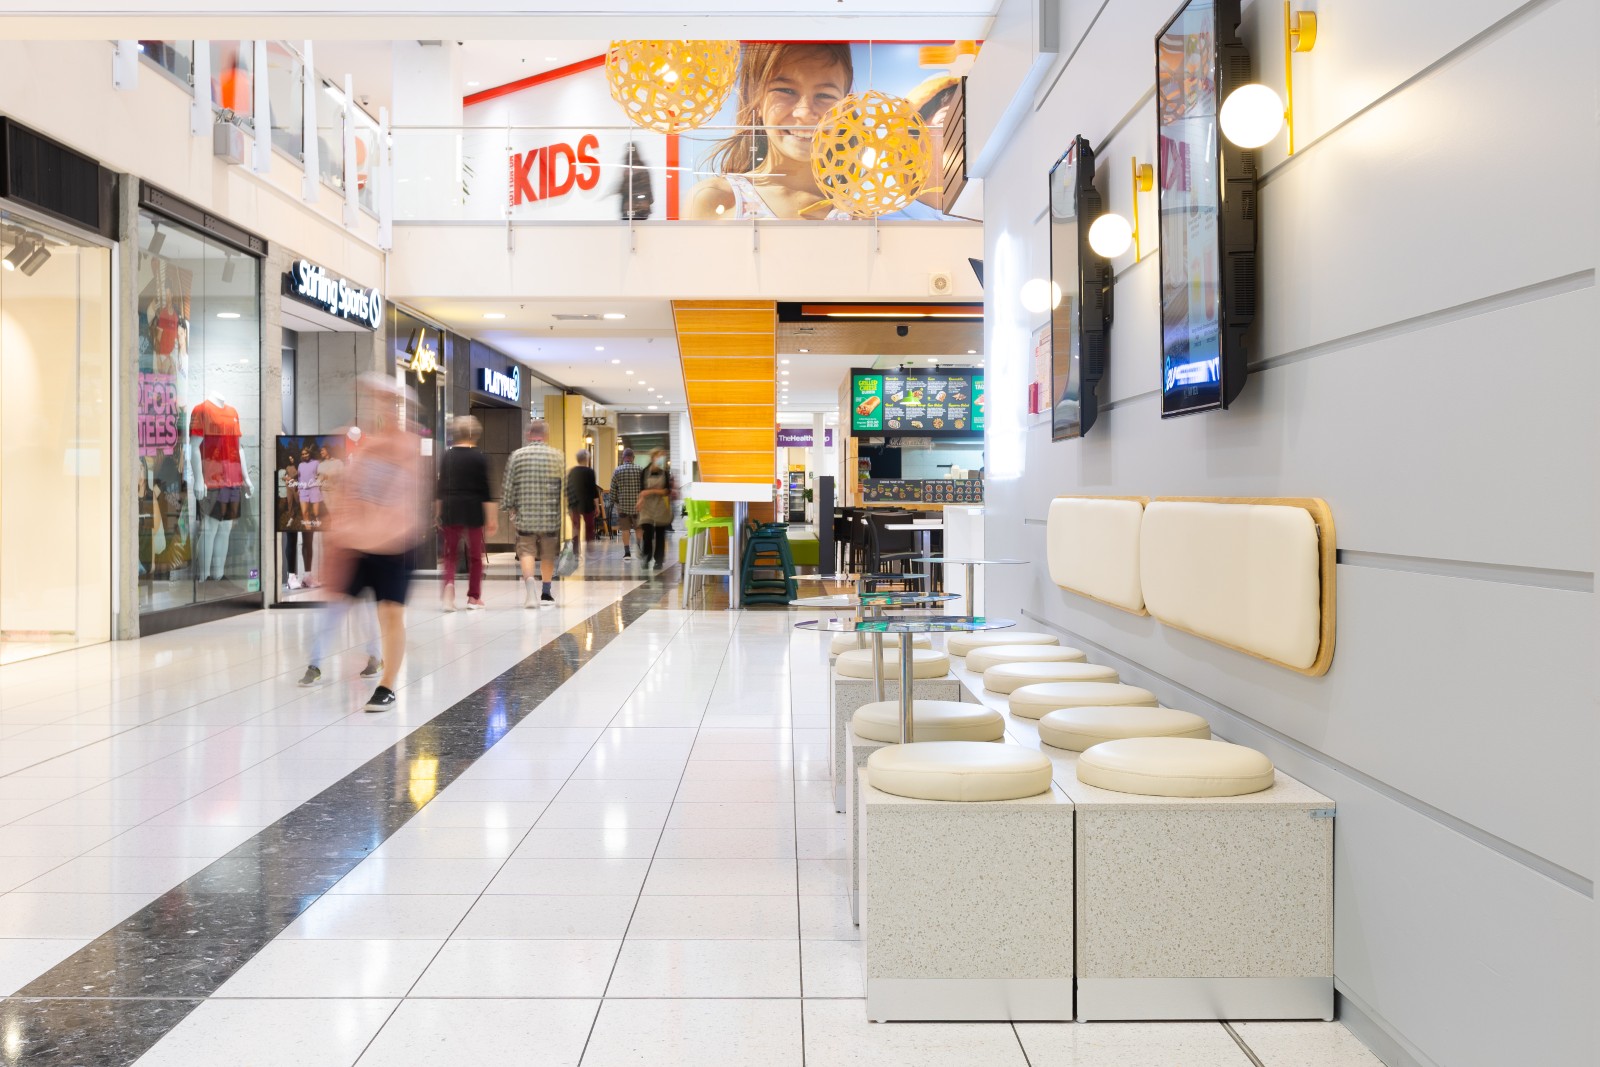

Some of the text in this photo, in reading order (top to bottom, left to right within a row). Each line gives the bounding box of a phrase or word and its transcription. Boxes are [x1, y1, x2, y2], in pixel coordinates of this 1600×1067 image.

[513, 133, 601, 206] KIDS
[298, 259, 339, 314] Stirling
[338, 278, 369, 319] Sports
[144, 383, 177, 415] FOR
[484, 367, 516, 400] PLATYPUS
[138, 414, 177, 446] TEES
